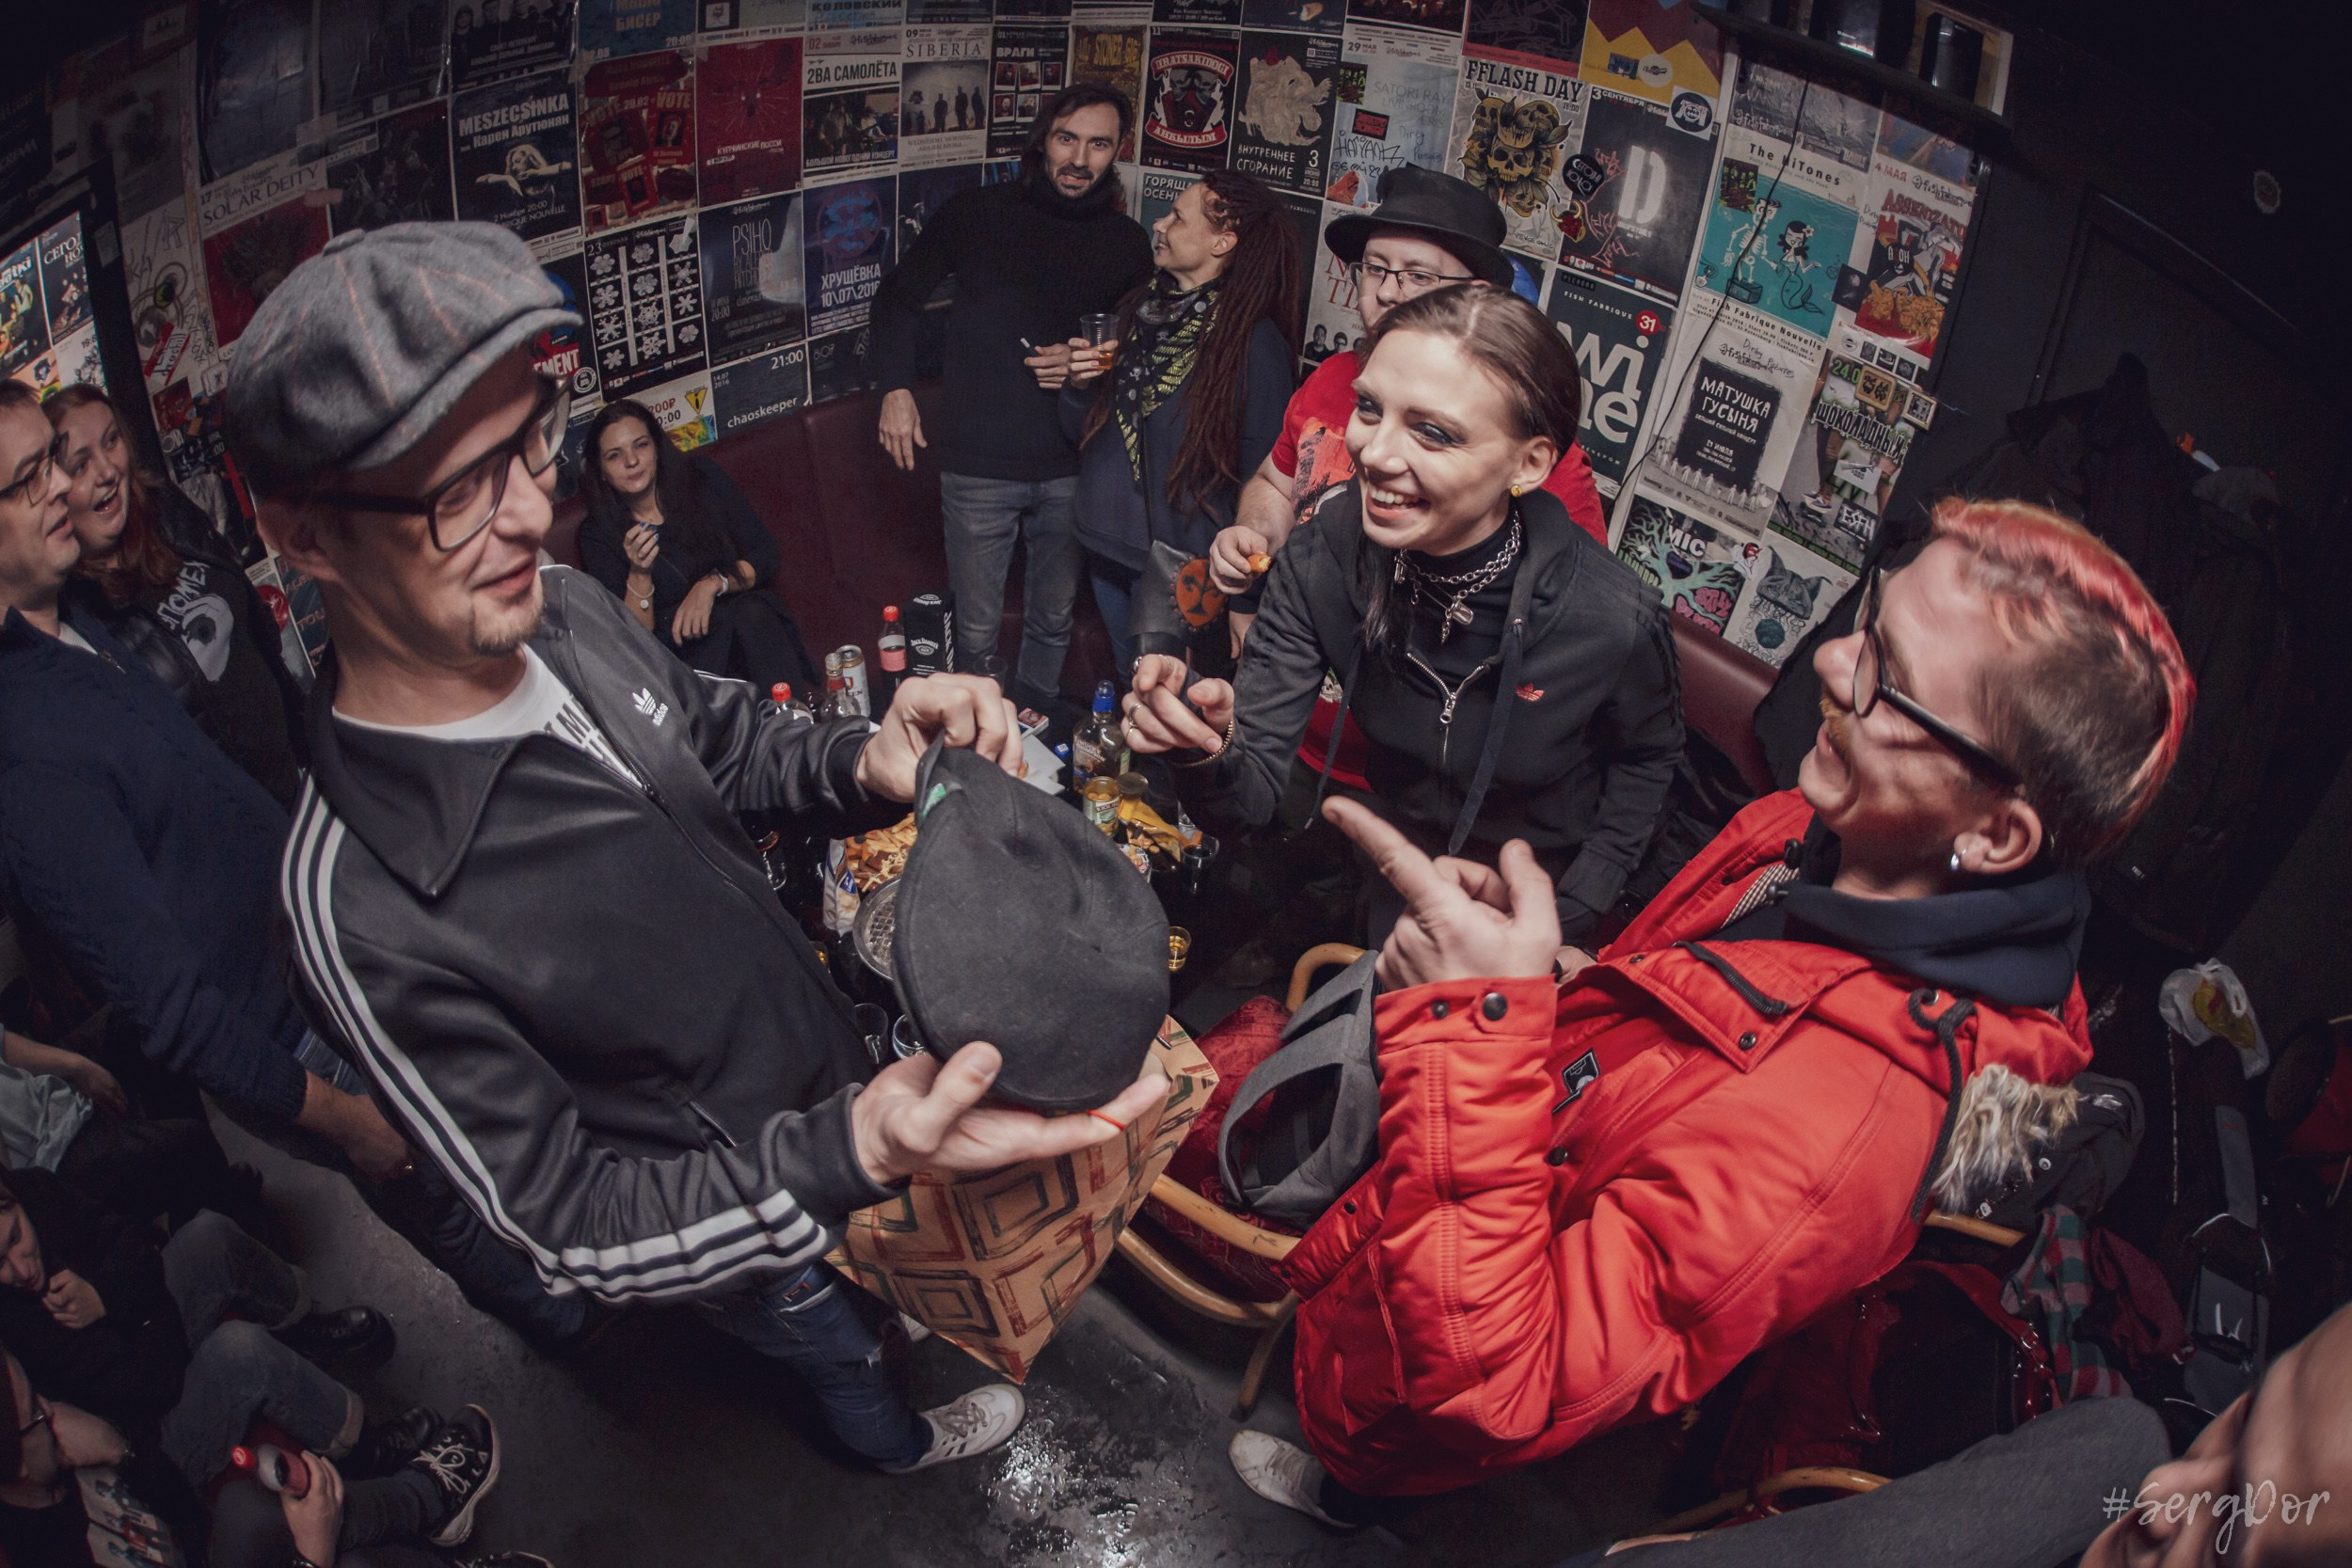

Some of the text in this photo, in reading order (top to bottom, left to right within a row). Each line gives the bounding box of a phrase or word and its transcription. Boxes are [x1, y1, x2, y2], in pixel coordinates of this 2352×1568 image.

[905, 29, 918, 38] 09
[809, 38, 821, 50] 02
[906, 42, 982, 58] SIBERIA
[995, 46, 1035, 57] ВРАГИ
[1347, 41, 1361, 52] 29
[807, 59, 898, 85] 2ВА САМОЛЁТА
[1466, 59, 1539, 93] FFLASH
[1543, 75, 1583, 103] DAY
[656, 91, 692, 109] VOTE
[1591, 87, 1602, 101] 3
[1602, 89, 1645, 107] СЕНТЯБРЯ
[1237, 144, 1295, 163] ВНУТРЕННЕЕ
[1309, 150, 1319, 167] 3
[1749, 142, 1774, 161] The
[1236, 158, 1295, 181] СГОРАНИЕ
[1883, 164, 1908, 182] МАЯ
[203, 188, 262, 227] SOLAR
[266, 164, 319, 198] DEITY
[732, 218, 772, 257] PSIHO
[821, 263, 882, 291] ХРУЩЁВКА
[1564, 291, 1632, 320] FISH FABRIQUE
[1639, 315, 1657, 332] 31
[1734, 307, 1777, 331] Fabrique
[1779, 326, 1823, 352] Nouvelle
[533, 349, 580, 376] EMENT
[771, 349, 804, 370] 21:00
[1700, 376, 1771, 419] МАТУШКА
[726, 396, 799, 430] chaoskeeper
[1702, 396, 1758, 434] ГУСЫНЯ
